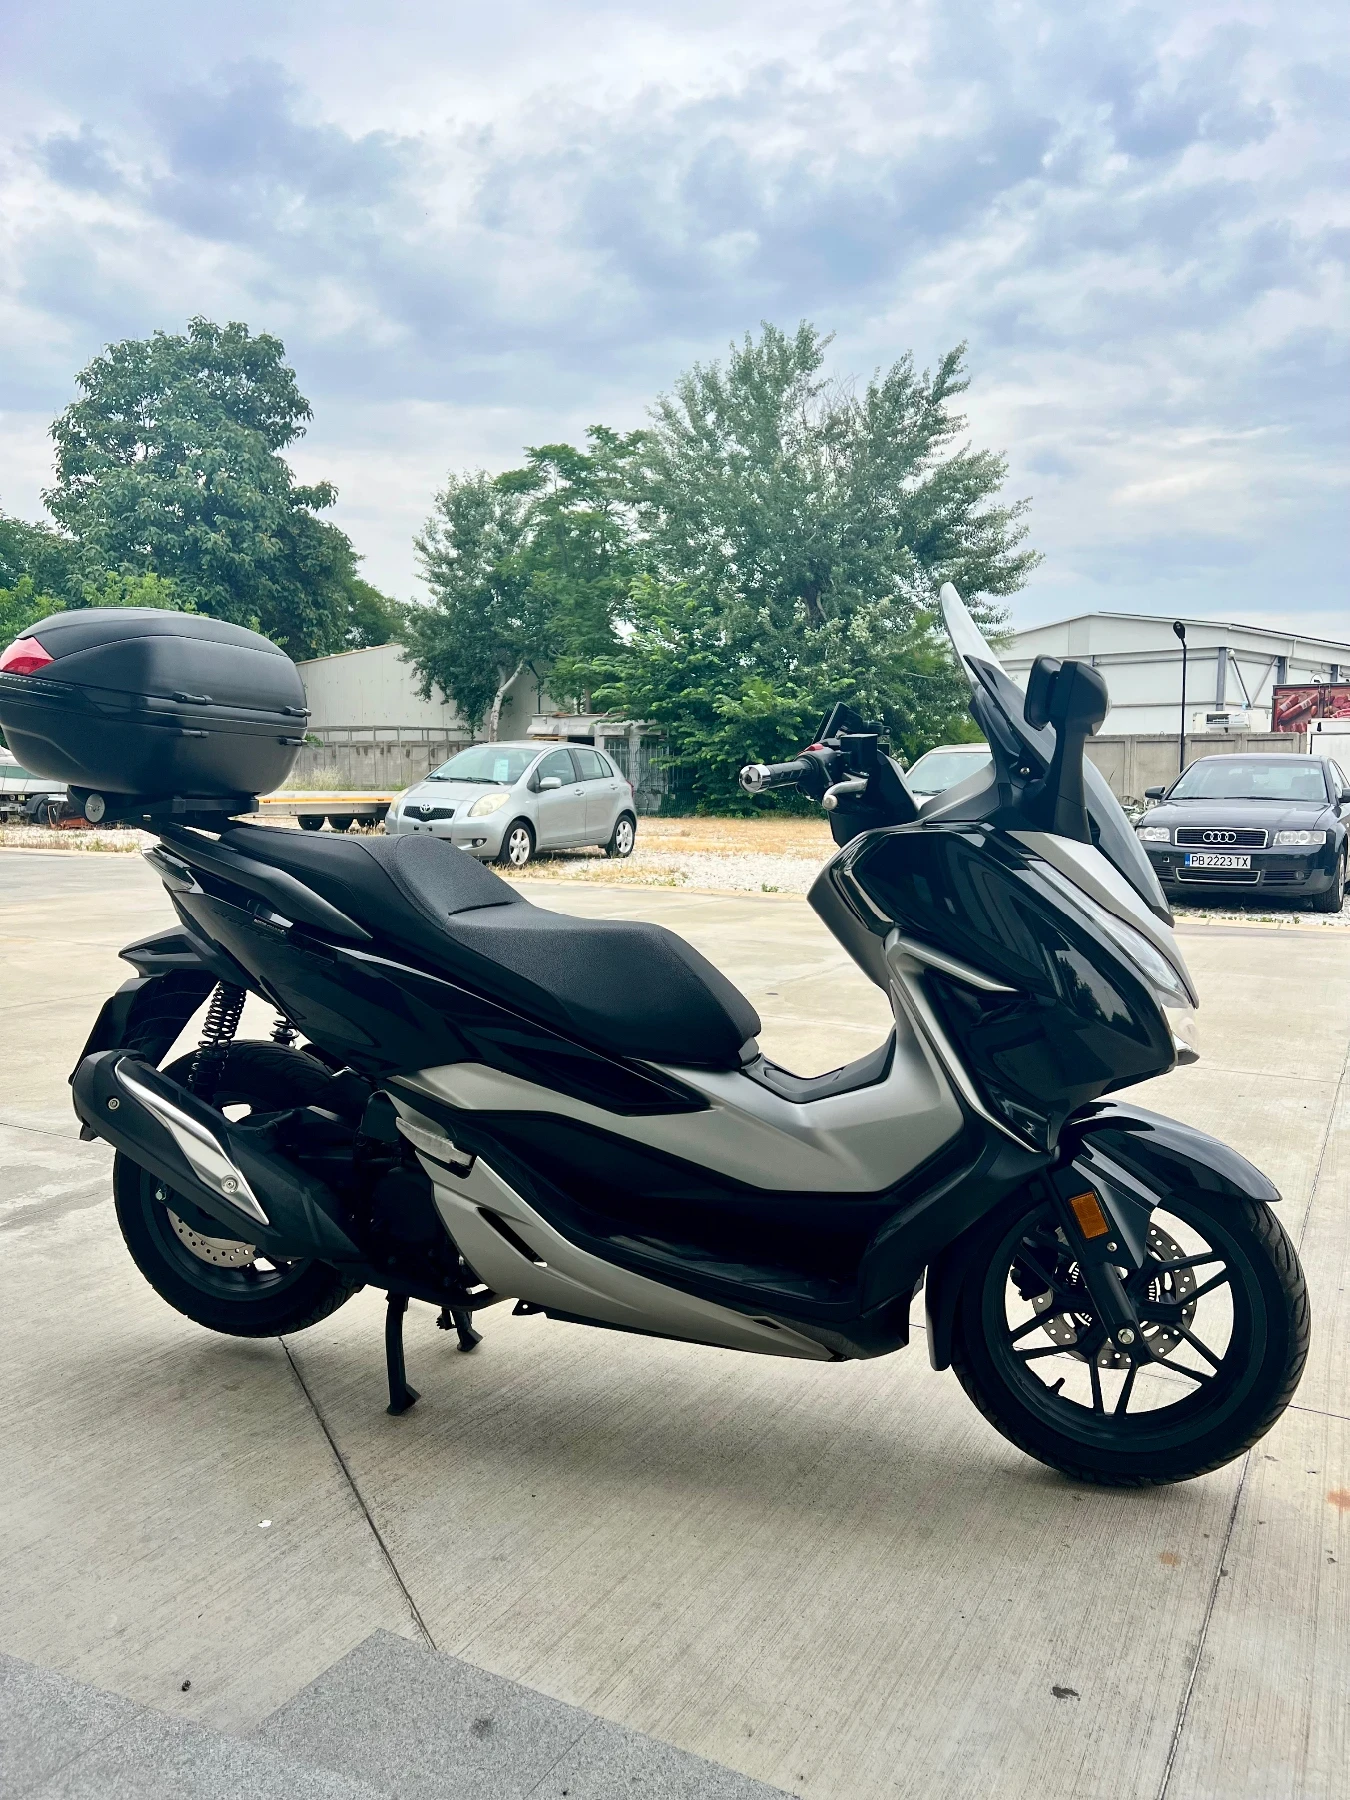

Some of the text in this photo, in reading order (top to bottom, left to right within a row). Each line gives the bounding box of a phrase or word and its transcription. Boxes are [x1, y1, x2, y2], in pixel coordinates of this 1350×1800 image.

[1191, 855, 1205, 865] PB
[1207, 856, 1232, 866] 2223
[1235, 857, 1248, 867] TX
